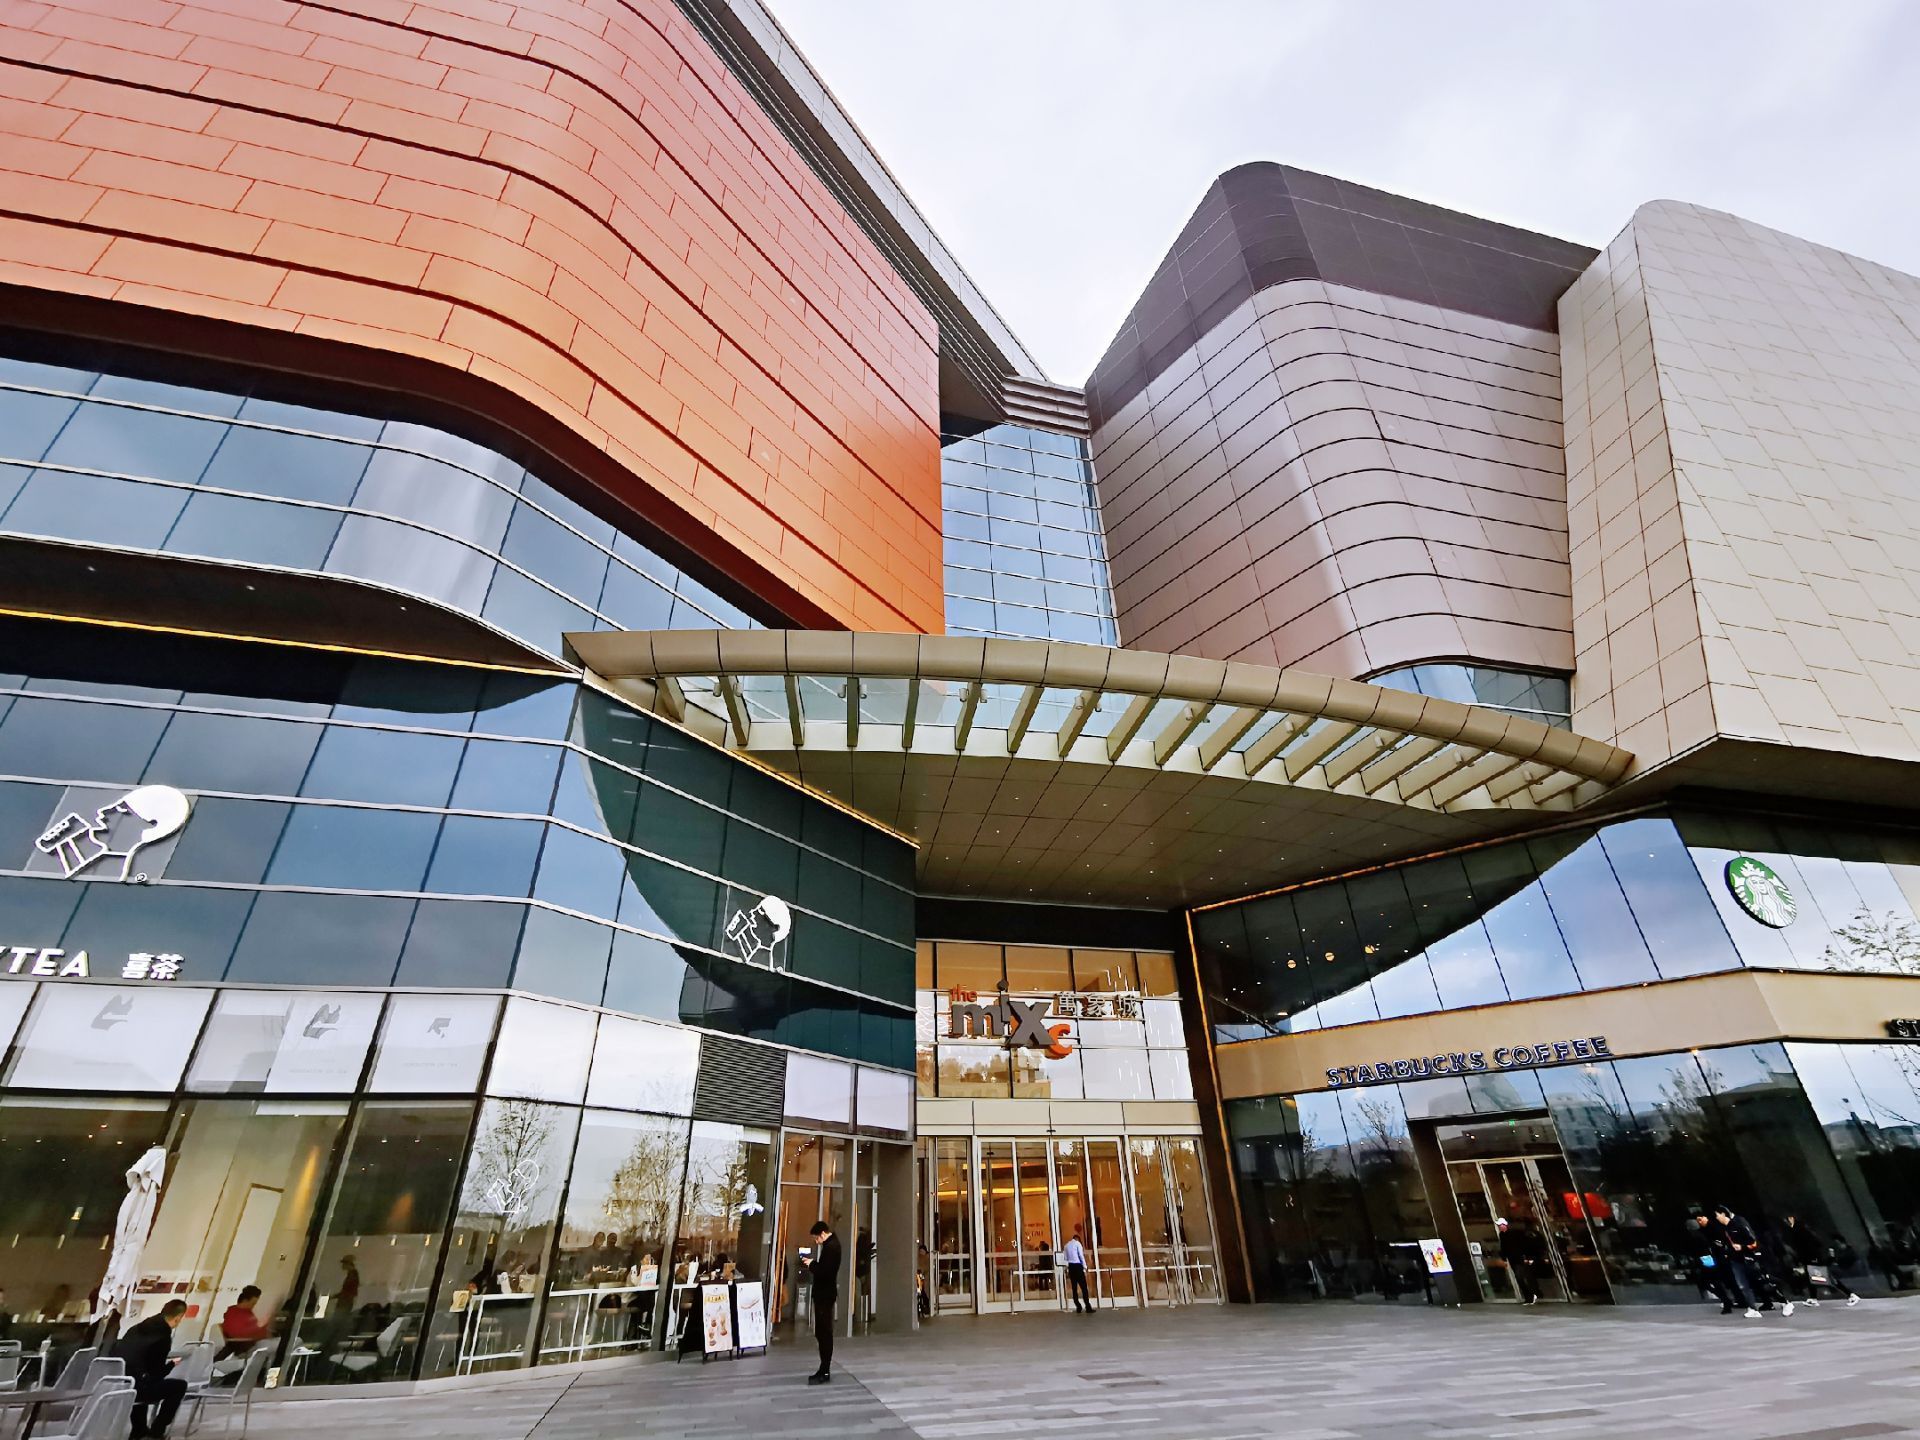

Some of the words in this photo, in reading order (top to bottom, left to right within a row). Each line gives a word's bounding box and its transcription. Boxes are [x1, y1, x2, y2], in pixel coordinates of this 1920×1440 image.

[0, 946, 90, 977] TEA
[122, 953, 184, 980] 喜茶
[950, 983, 977, 1002] the
[1326, 1050, 1489, 1087] STARBUCKS
[1492, 1035, 1612, 1068] COFFEE
